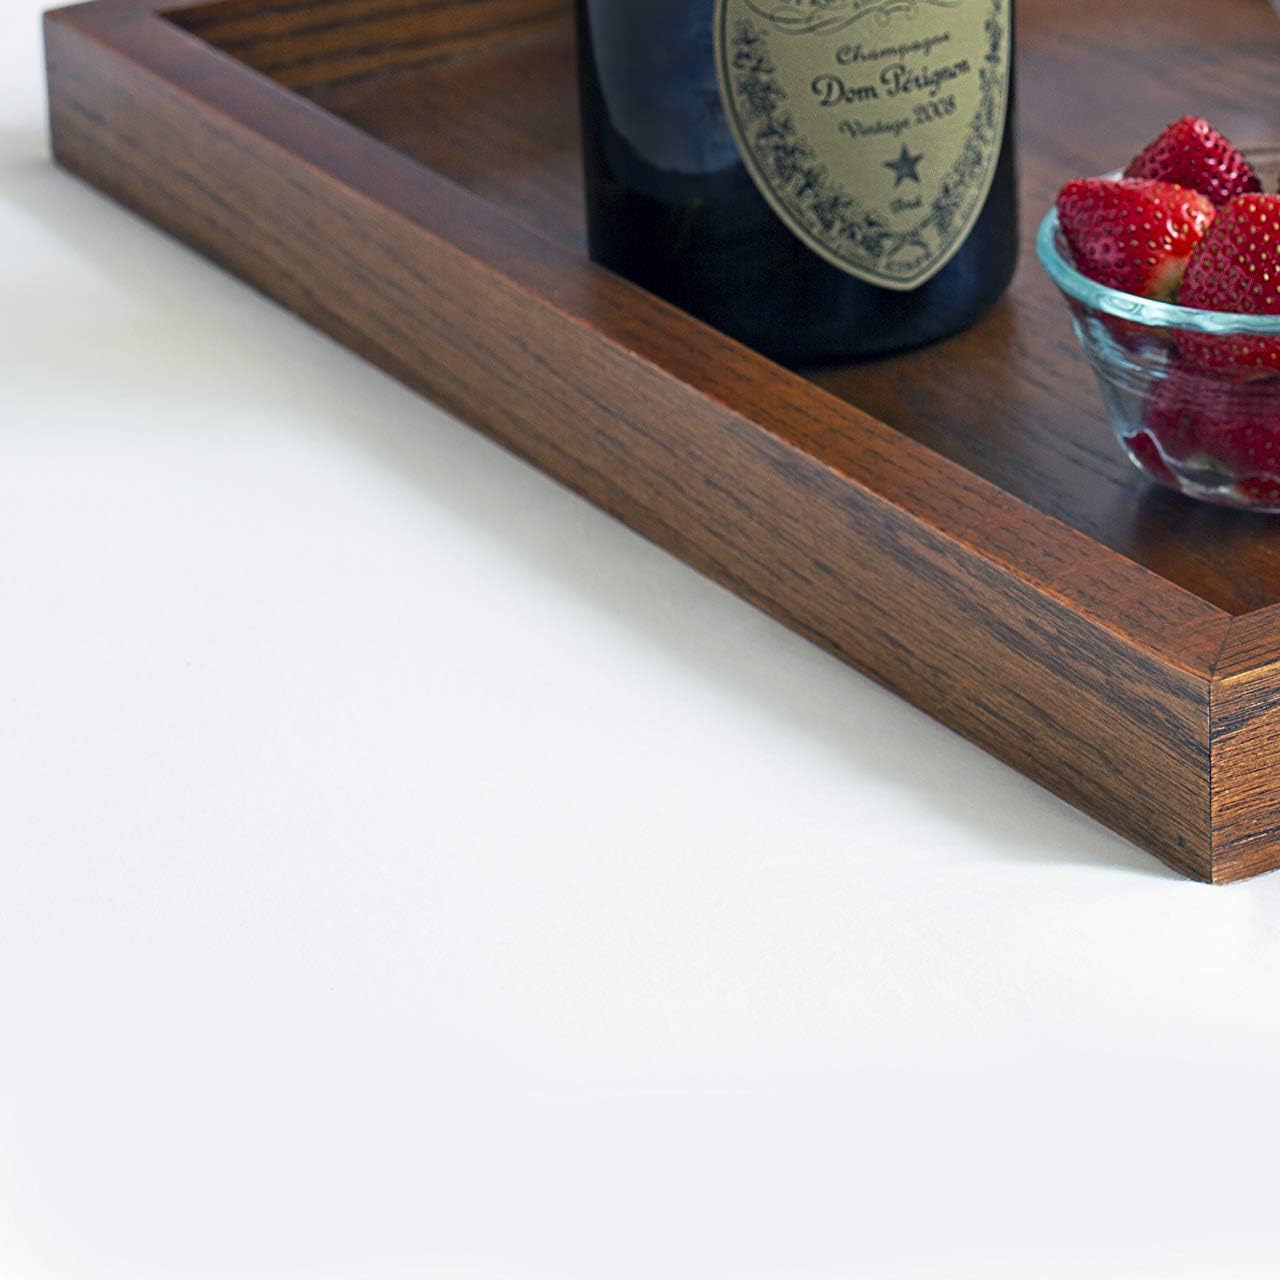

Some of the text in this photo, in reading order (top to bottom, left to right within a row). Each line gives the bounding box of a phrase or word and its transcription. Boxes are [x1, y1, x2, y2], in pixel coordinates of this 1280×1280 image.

[836, 32, 950, 66] Champagne
[811, 73, 879, 107] Dom
[838, 118, 911, 138] Vintage
